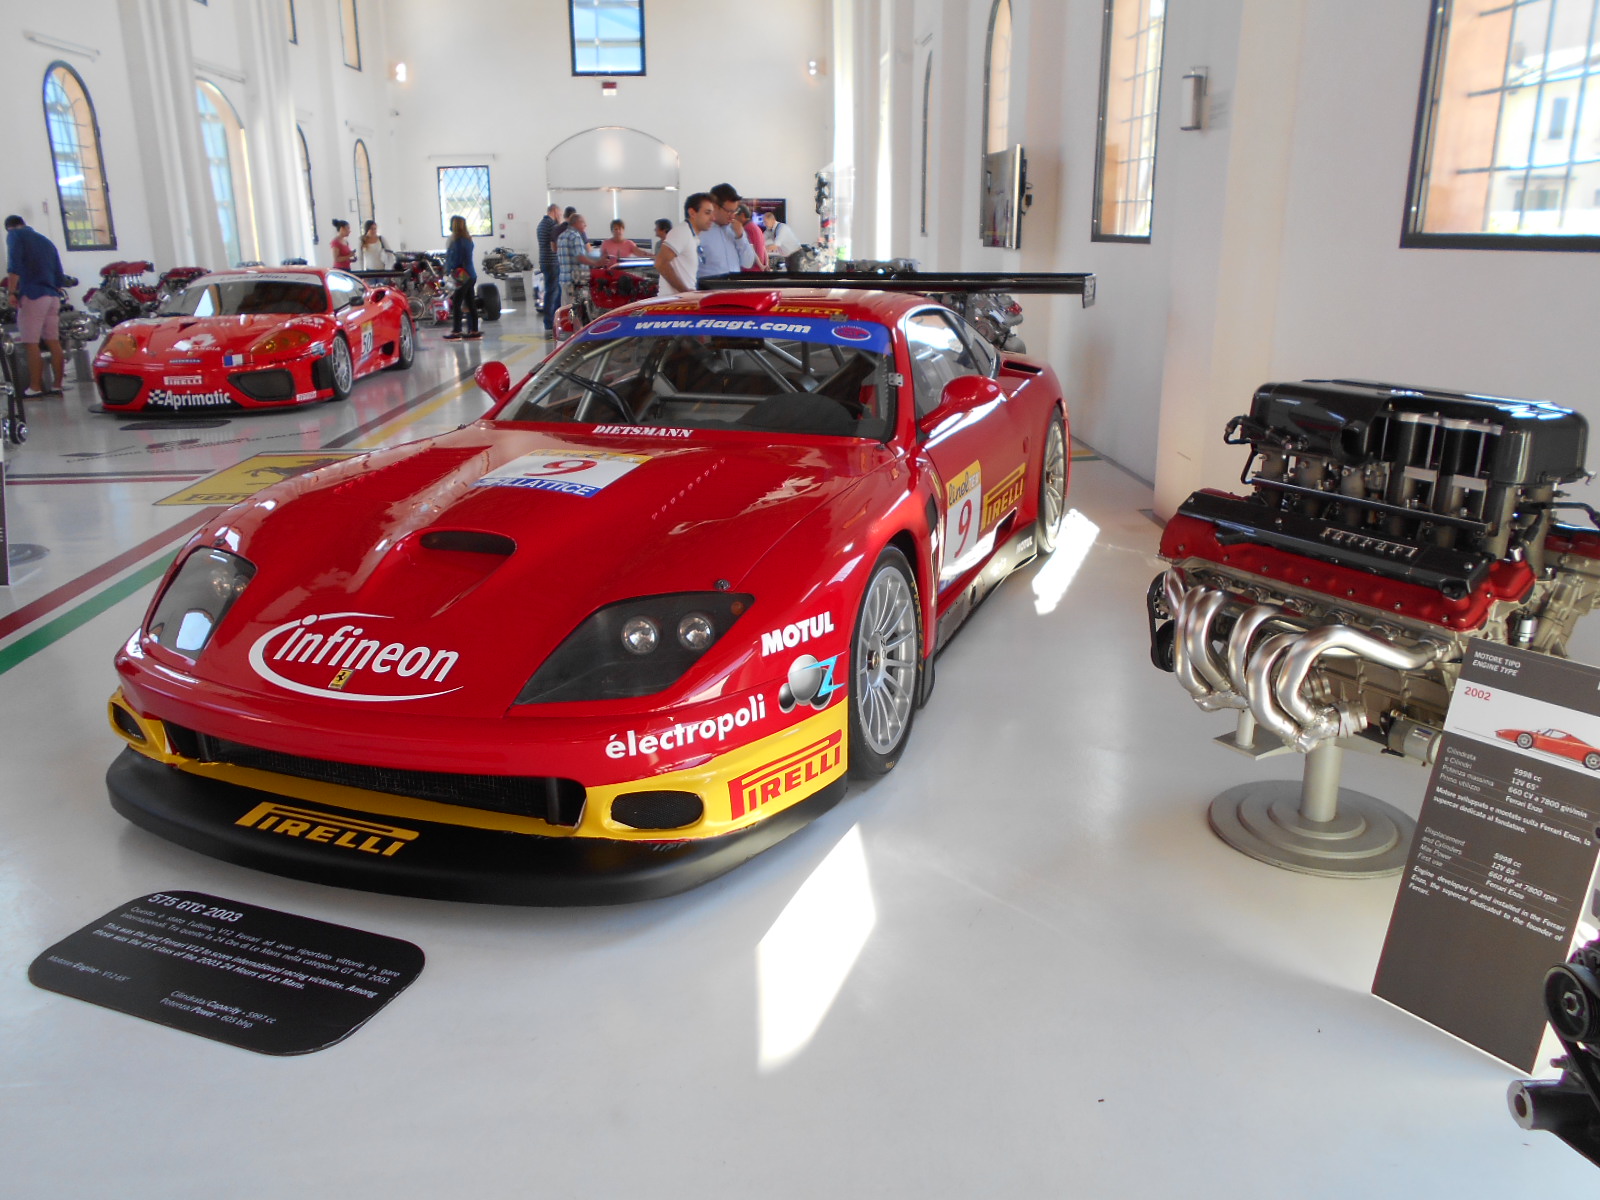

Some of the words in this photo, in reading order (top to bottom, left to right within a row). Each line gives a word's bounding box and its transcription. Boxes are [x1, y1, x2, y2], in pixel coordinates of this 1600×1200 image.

[769, 306, 843, 315] PIRELLI
[634, 318, 812, 334] www.fiagt.com
[163, 375, 202, 386] PIRELLI
[164, 389, 231, 410] Aprimatic
[592, 425, 694, 438] DIETSMANN
[523, 459, 598, 476] 9
[980, 462, 1026, 532] PIRELLI
[954, 499, 972, 558] 9
[761, 611, 834, 657] MOTUL
[273, 614, 460, 683] infineon
[1474, 651, 1503, 665] MOTORE
[1504, 660, 1521, 668] TIPO
[1472, 660, 1499, 672] ENGINE
[1499, 667, 1519, 677] TYPE
[1464, 686, 1492, 701] 2002
[605, 693, 766, 759] électropoli
[727, 728, 842, 821] PIRELLI
[1514, 768, 1533, 779] 5998
[1506, 795, 1526, 807] Ferrari
[1527, 803, 1544, 814] Enzo
[1508, 786, 1523, 796] 660
[1523, 791, 1535, 799] CV
[1540, 796, 1560, 809] 7800
[234, 801, 420, 856] PIRELLI
[1436, 786, 1457, 798] Motore
[1539, 822, 1563, 836] Ferrari
[1563, 831, 1582, 844] Enzo,
[1425, 826, 1466, 846] Displacement
[1486, 880, 1508, 893] Ferrari
[1507, 888, 1525, 900] Enzo
[1488, 870, 1503, 881] 660
[1523, 884, 1543, 897] 7800
[1543, 893, 1558, 903] rpm
[148, 894, 180, 907] 575
[176, 900, 206, 913] GTC
[202, 907, 243, 922] 2003
[1437, 876, 1469, 892] developed
[1469, 888, 1479, 896] for
[1478, 893, 1493, 901] and
[1492, 898, 1521, 913] installed
[1530, 913, 1542, 922] the
[1542, 918, 1566, 932] Ferrari
[1470, 899, 1502, 916] dedicated
[1503, 912, 1511, 920] to
[1512, 916, 1525, 926] the
[1526, 922, 1553, 937] founder
[218, 928, 235, 936] V12
[236, 932, 261, 943] Ferrari
[276, 943, 295, 951] aver
[297, 948, 332, 961] riportato
[336, 957, 365, 969] vittorie
[379, 968, 400, 978] gare
[250, 944, 260, 952] Le
[260, 948, 281, 958] Mans
[303, 957, 339, 972] categoria
[354, 970, 367, 979] nel
[282, 967, 309, 981] racing
[345, 985, 379, 998] Among
